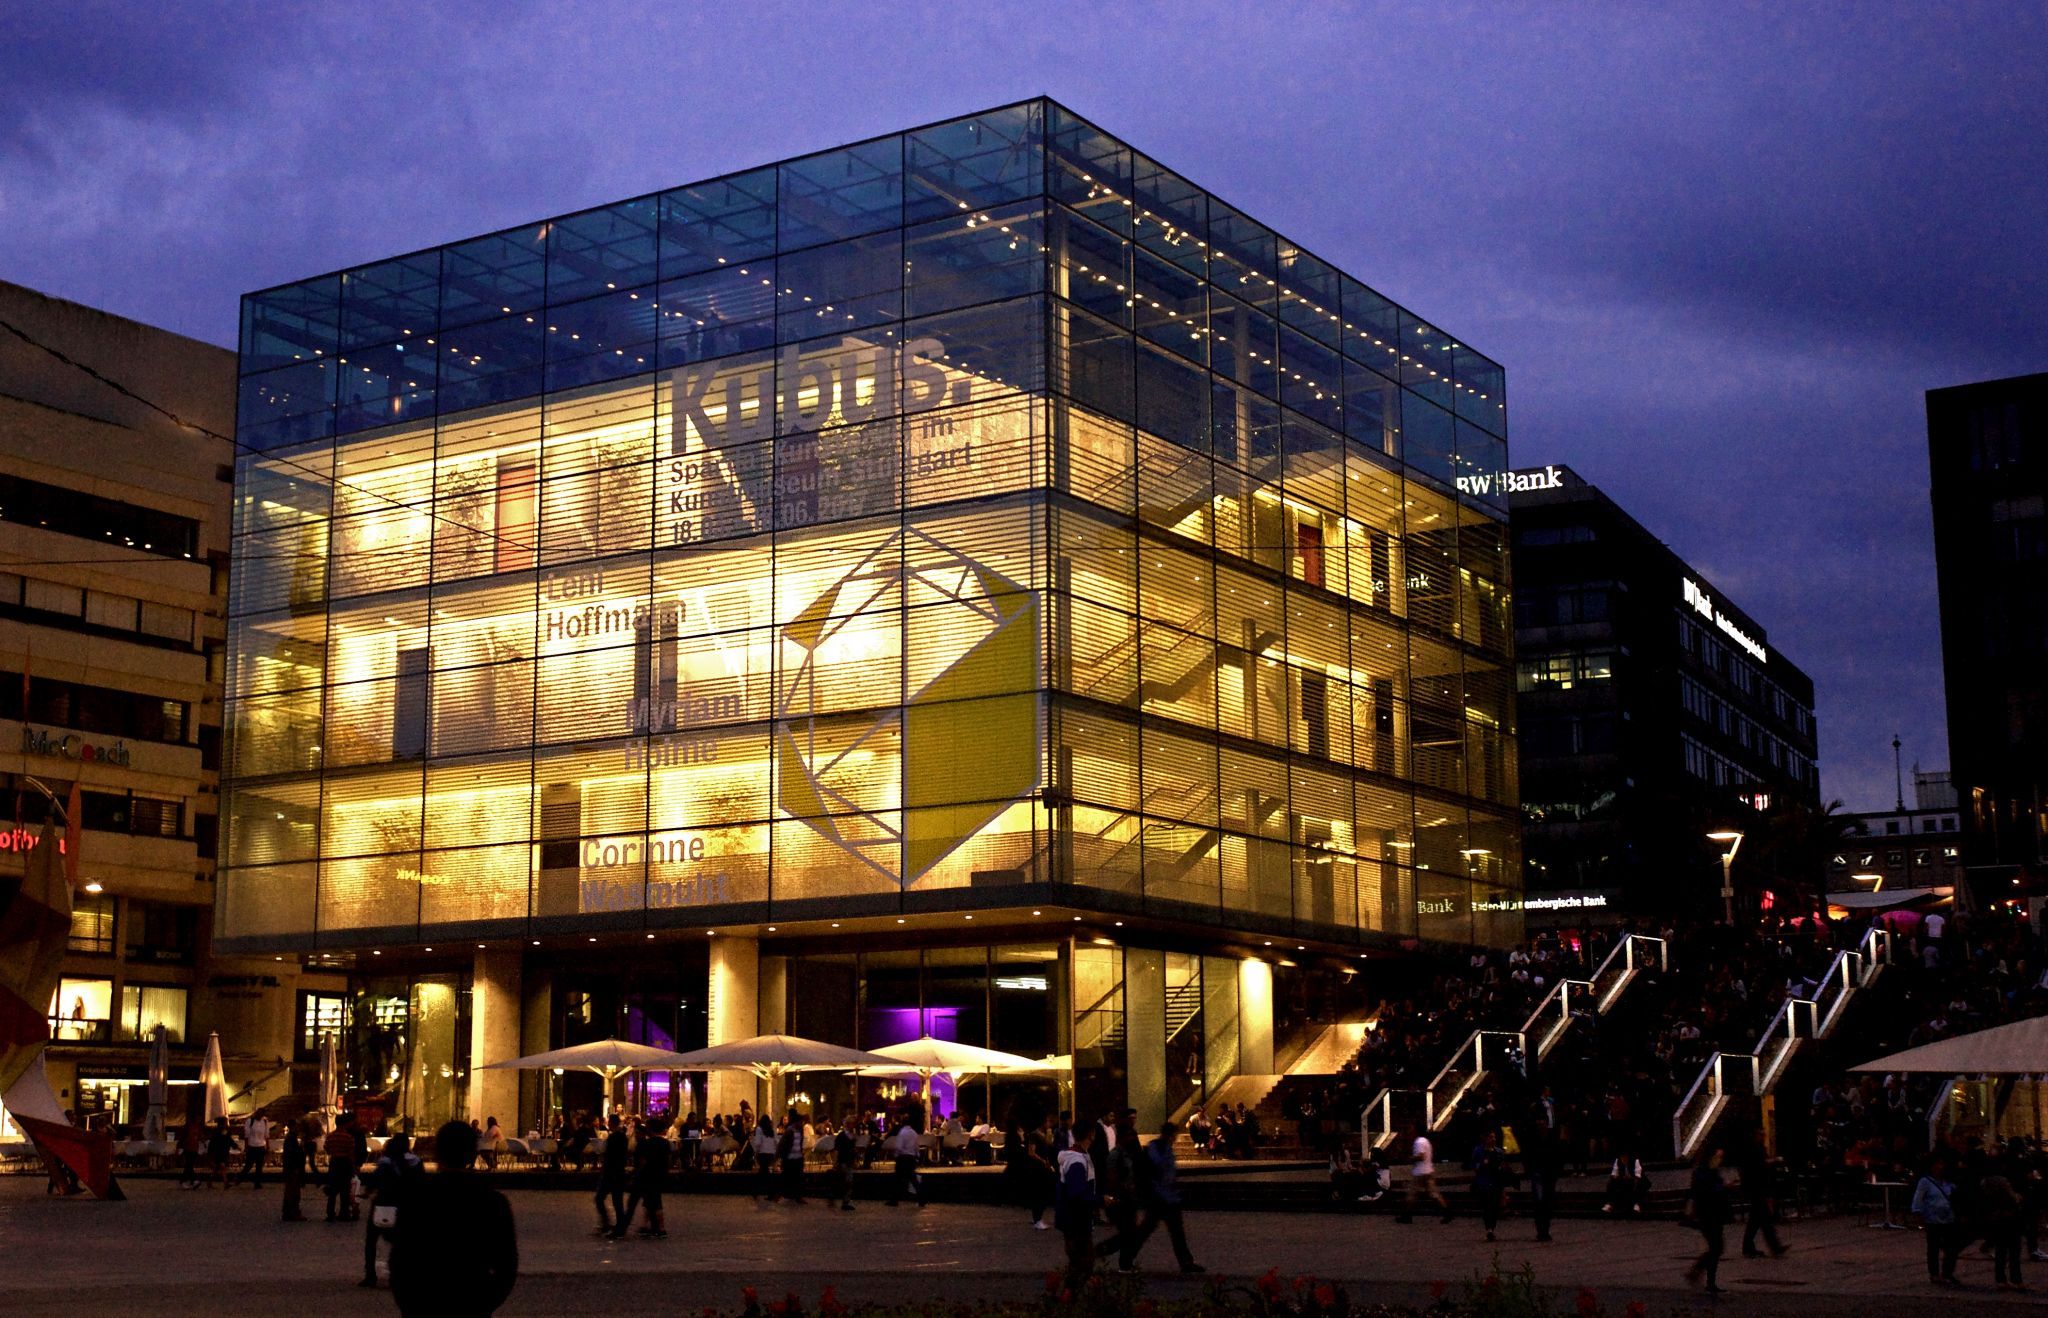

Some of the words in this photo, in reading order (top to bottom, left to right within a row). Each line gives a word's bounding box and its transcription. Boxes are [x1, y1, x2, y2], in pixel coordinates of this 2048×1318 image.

[1501, 465, 1564, 493] Bank
[547, 566, 604, 600] Leni
[582, 836, 705, 869] Corinne
[1417, 898, 1455, 914] Bank
